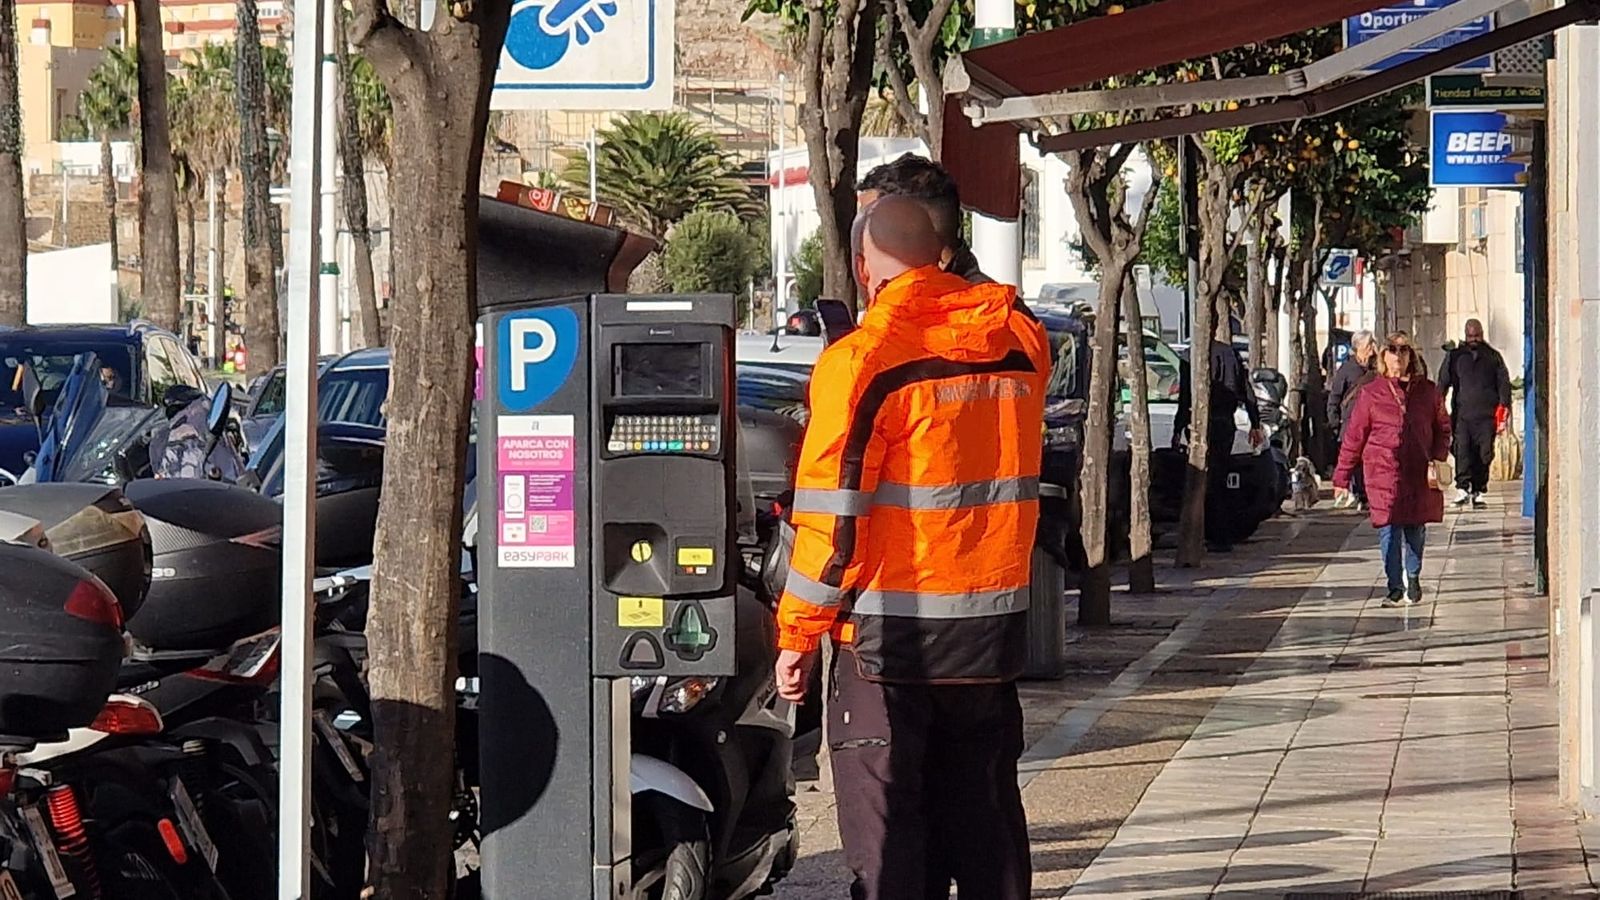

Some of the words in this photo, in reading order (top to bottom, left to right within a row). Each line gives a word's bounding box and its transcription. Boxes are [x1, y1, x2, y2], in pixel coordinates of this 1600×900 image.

[1504, 87, 1517, 96] de
[1446, 132, 1511, 152] BEEP
[510, 318, 556, 391] P
[1337, 344, 1347, 359] P
[503, 439, 543, 449] APARCA
[545, 439, 569, 449] CON
[508, 450, 563, 459] NOSOTROS
